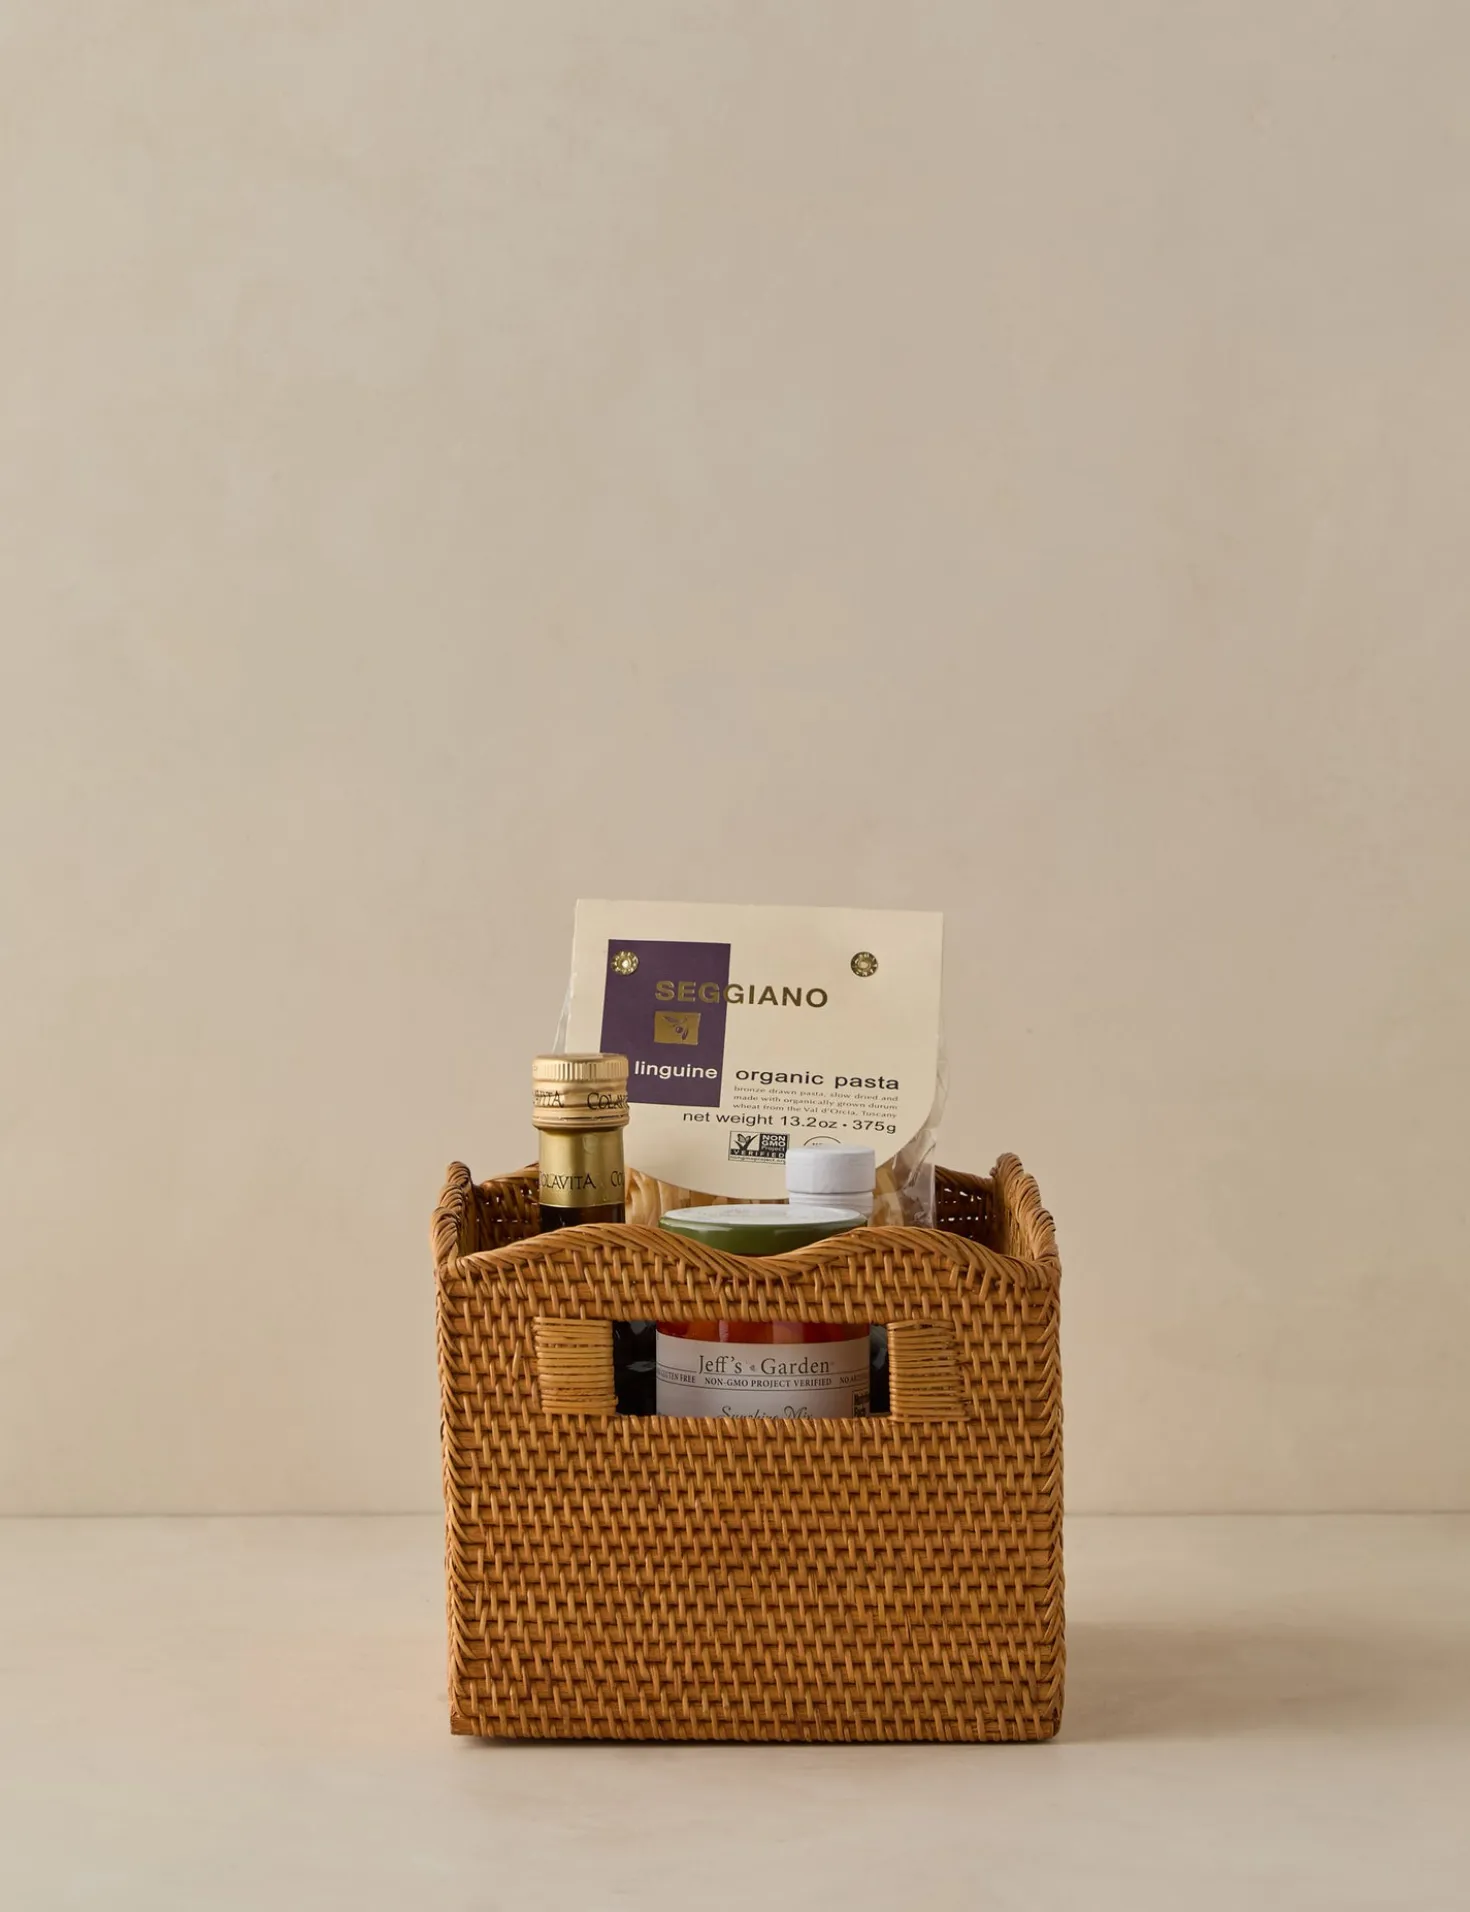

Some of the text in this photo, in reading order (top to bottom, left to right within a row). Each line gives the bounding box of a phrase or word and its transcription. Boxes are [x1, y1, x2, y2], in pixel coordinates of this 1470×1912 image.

[655, 980, 828, 1008] SEGGIANO
[634, 1061, 718, 1080] linguine
[735, 1069, 899, 1091] organic pasta
[783, 1098, 834, 1107] organically
[683, 1111, 896, 1134] net weight 13.2oz 375g
[862, 1110, 897, 1118] Tuscany
[733, 1149, 785, 1159] VERIFIED
[541, 1172, 597, 1190] OLAVITA
[699, 1355, 829, 1374] Jeff's Garden
[680, 1374, 696, 1383] FREE
[704, 1377, 832, 1388] NON-GMO PROJECT VERIFIED
